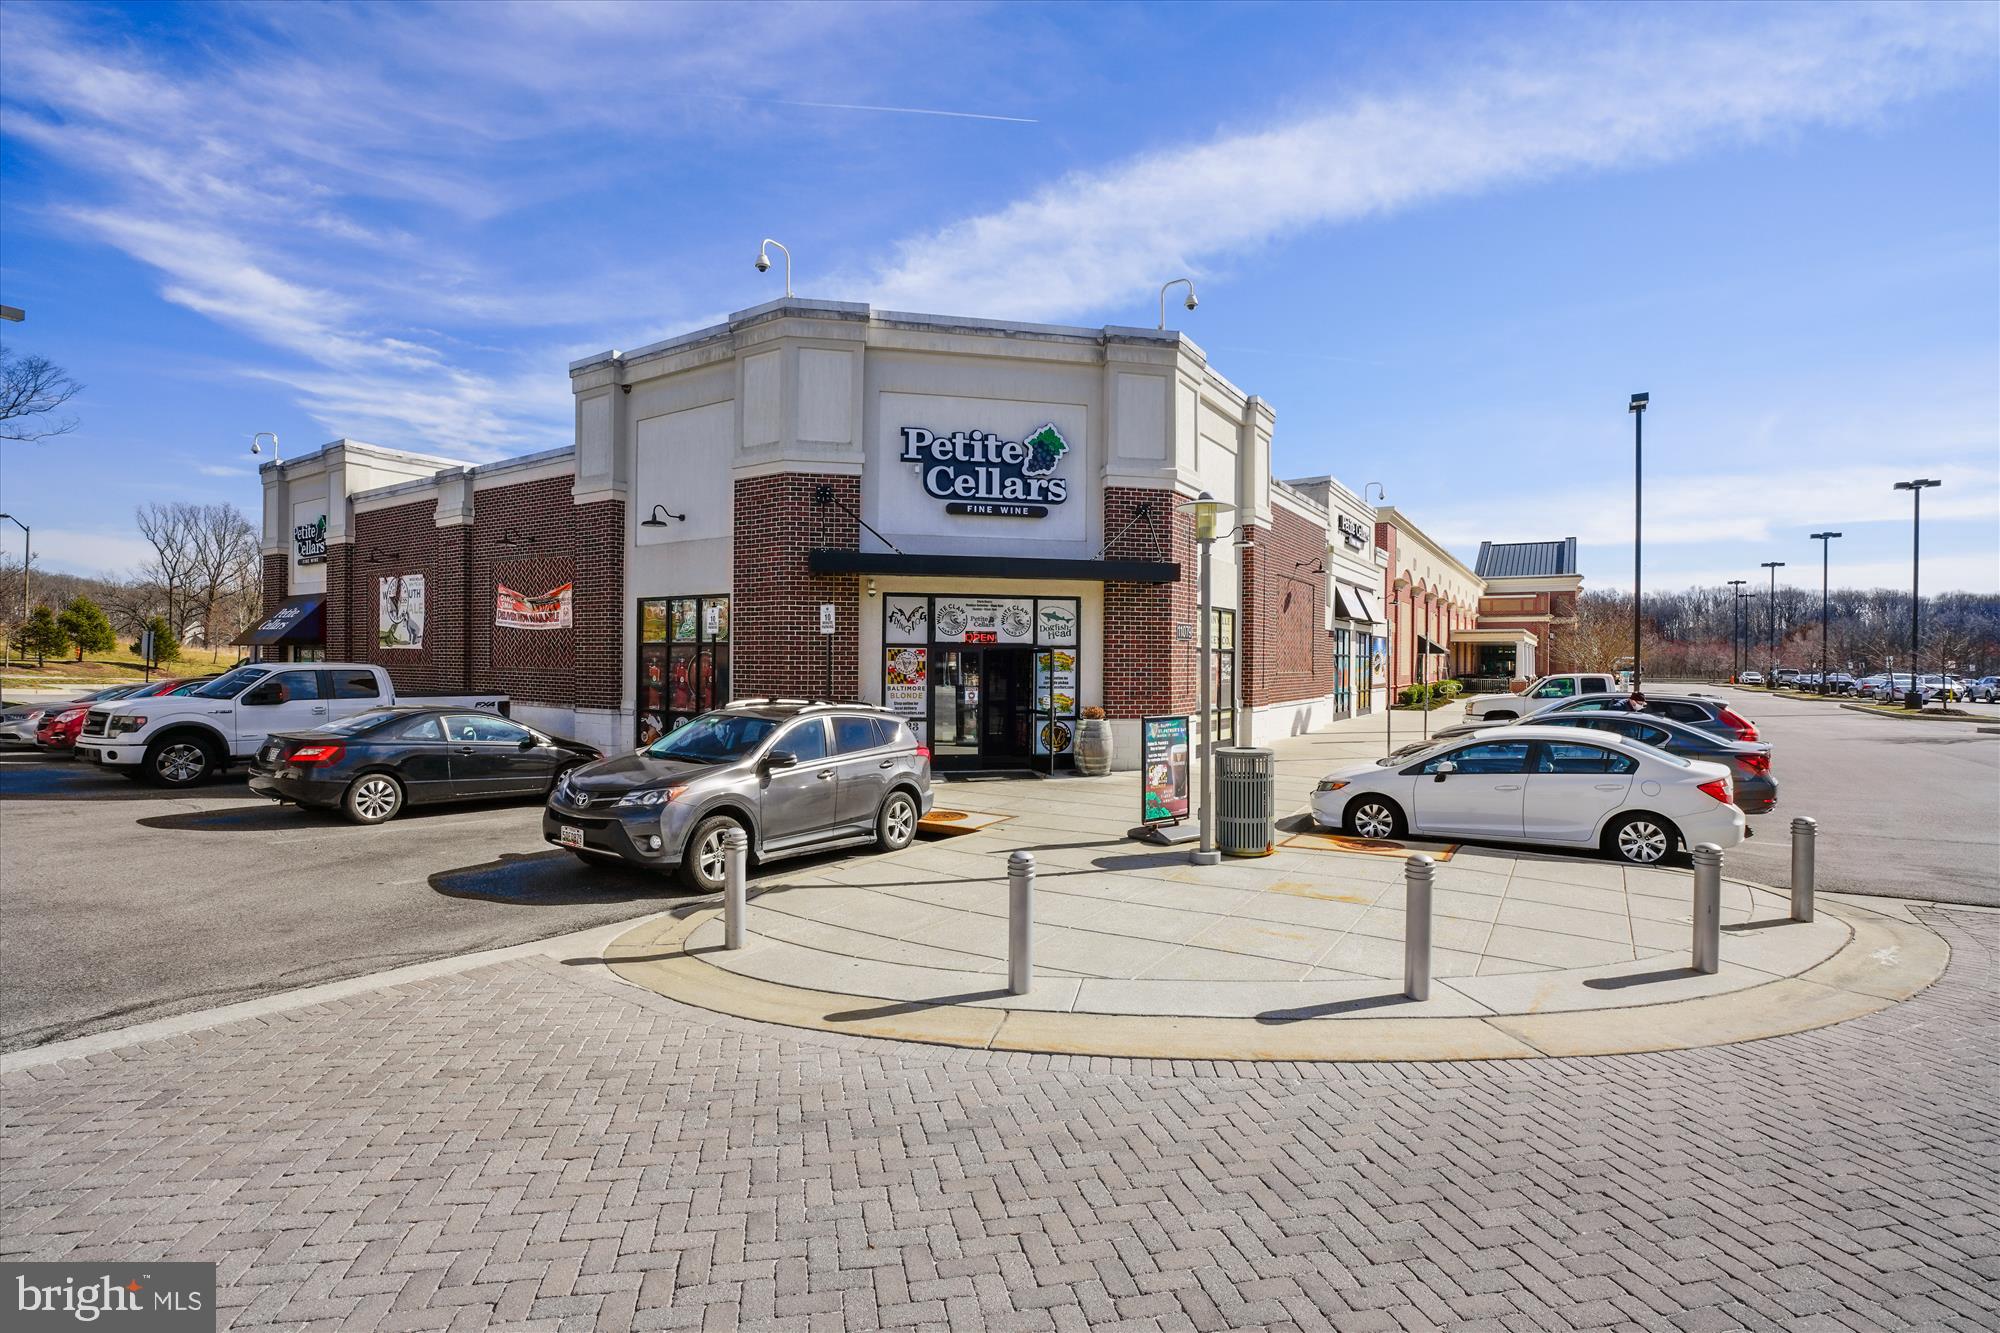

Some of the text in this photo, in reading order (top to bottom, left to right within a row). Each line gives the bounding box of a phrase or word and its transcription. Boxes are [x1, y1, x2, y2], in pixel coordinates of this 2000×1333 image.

[903, 428, 1024, 464] Petite
[926, 465, 1067, 501] Cellars
[967, 505, 1029, 515] FINE WINE
[293, 524, 316, 540] Petite
[297, 539, 326, 555] Cellars
[936, 603, 965, 625] WHITE CLAW
[1001, 605, 1029, 626] WHITE CLAW
[1040, 624, 1069, 633] Dogfish
[1048, 629, 1071, 639] Head
[965, 632, 995, 642] OPEN
